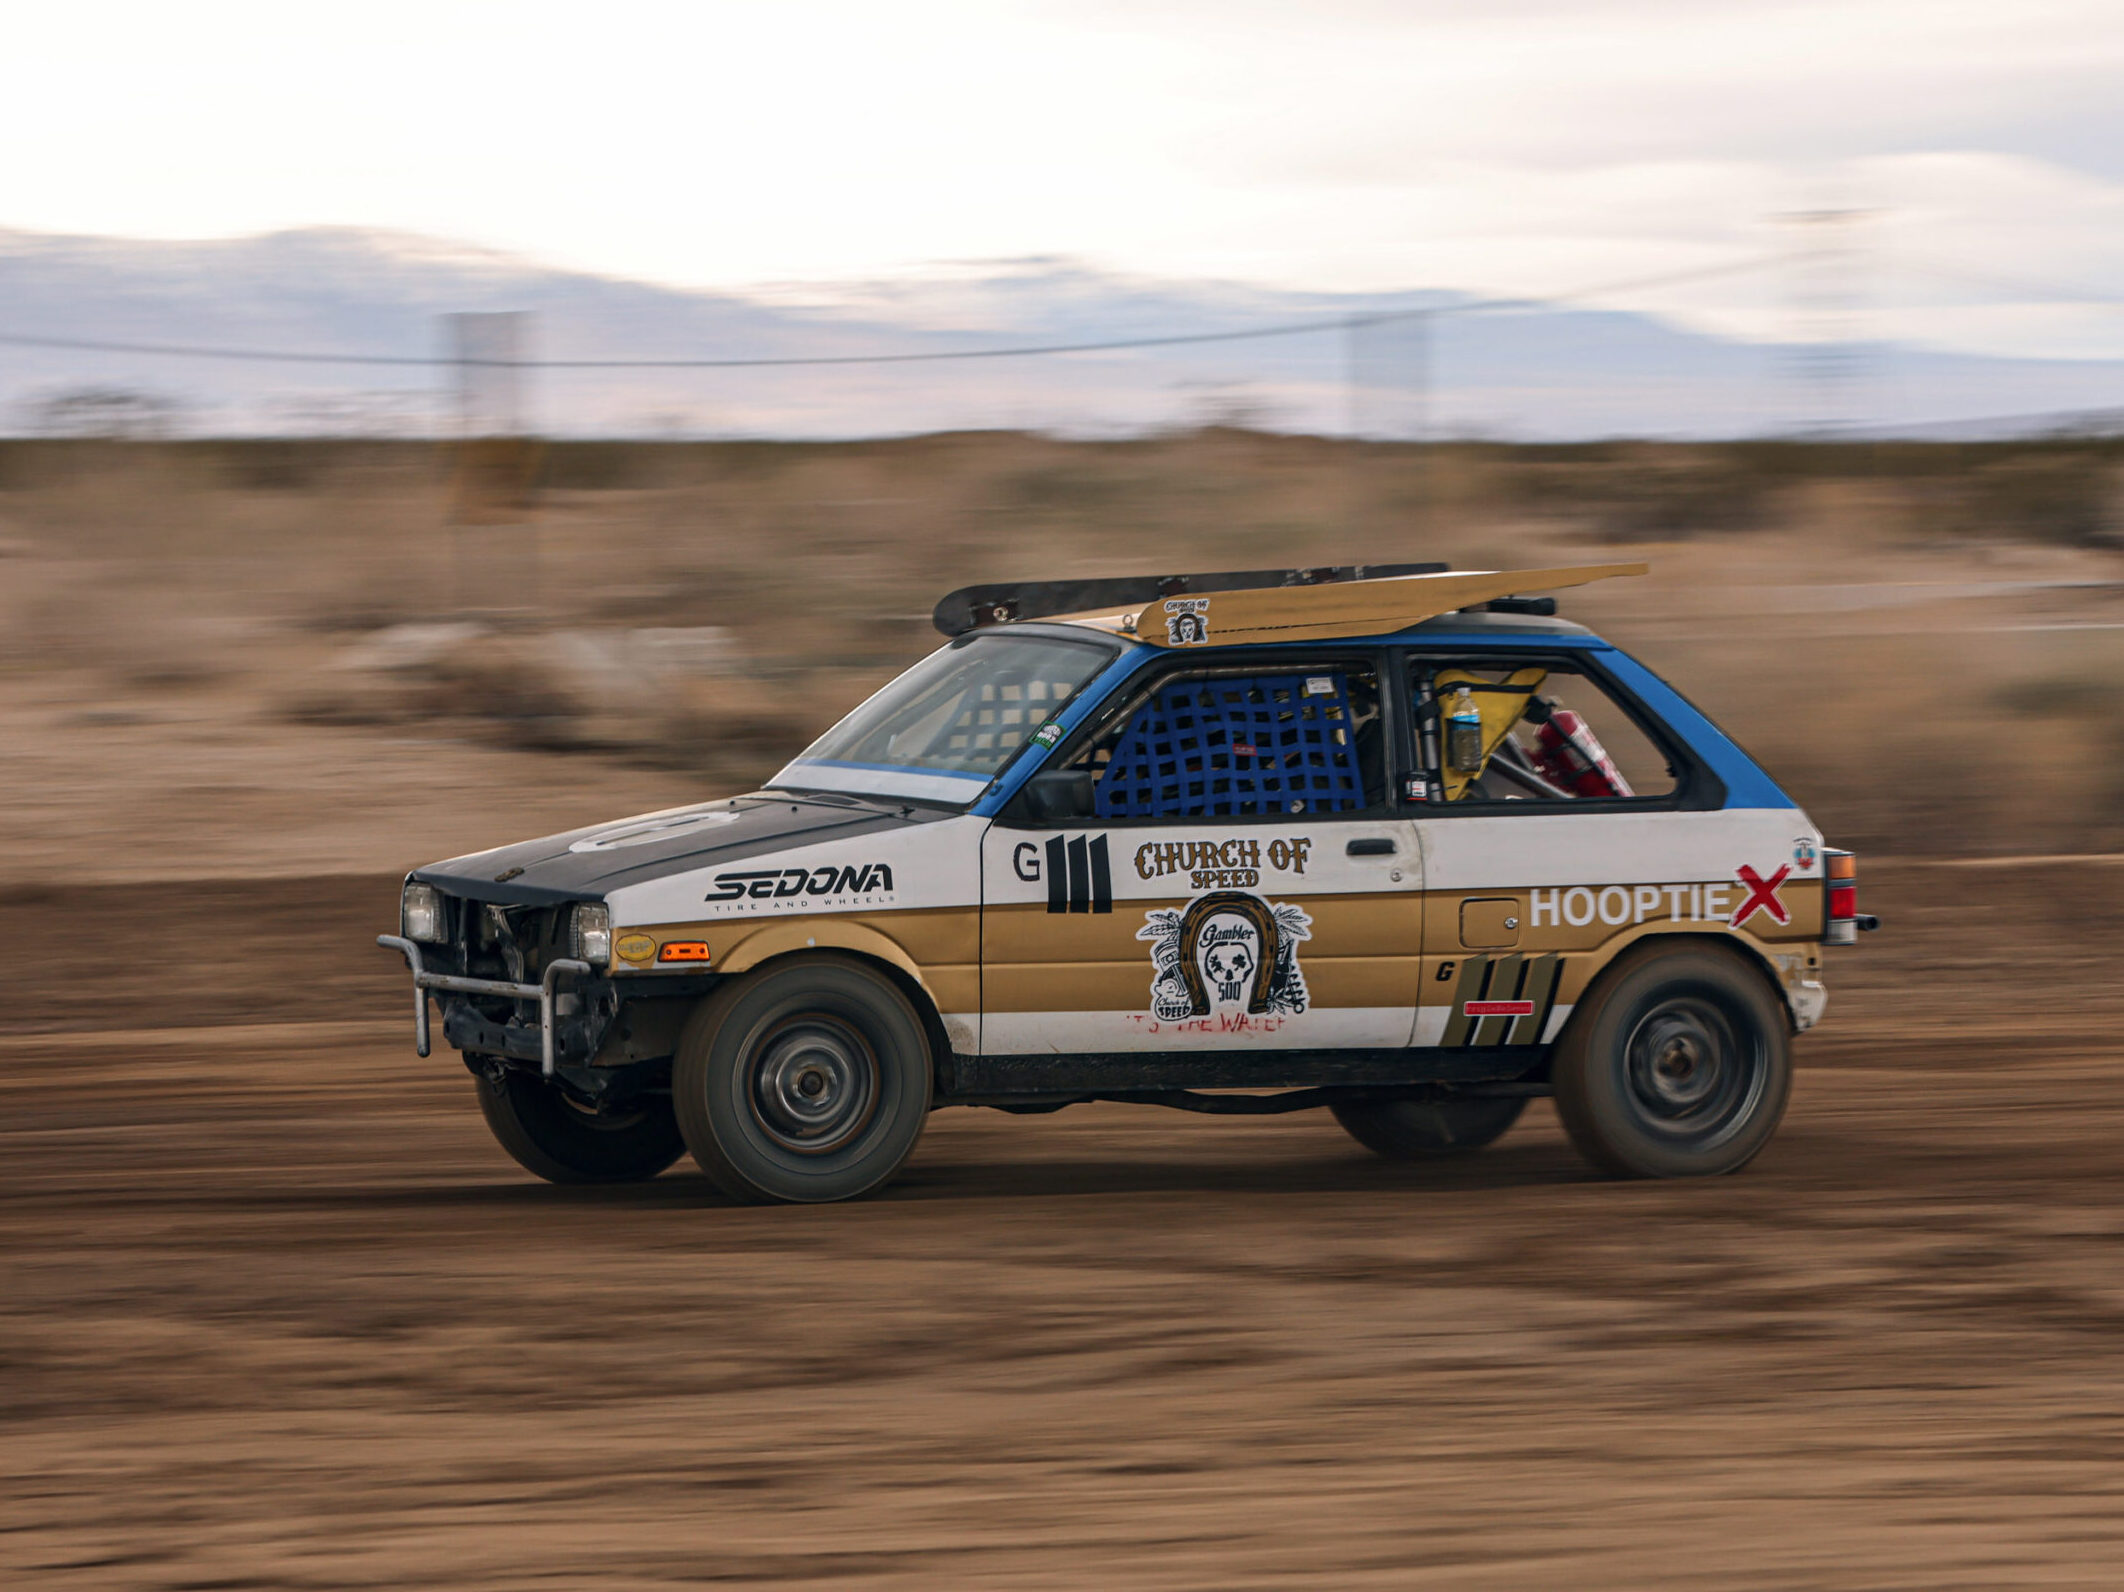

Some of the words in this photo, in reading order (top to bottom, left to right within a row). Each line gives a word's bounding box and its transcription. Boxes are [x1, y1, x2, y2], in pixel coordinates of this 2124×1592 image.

[1134, 839, 1261, 880] CHURCH
[1267, 837, 1311, 874] OF
[705, 863, 893, 901] SEDONA
[1191, 869, 1259, 889] SPEED
[714, 903, 757, 912] TIRE
[774, 901, 808, 909] AND
[1199, 924, 1255, 947] Gambler
[1218, 981, 1241, 1002] 500
[1158, 1006, 1190, 1017] SPEED
